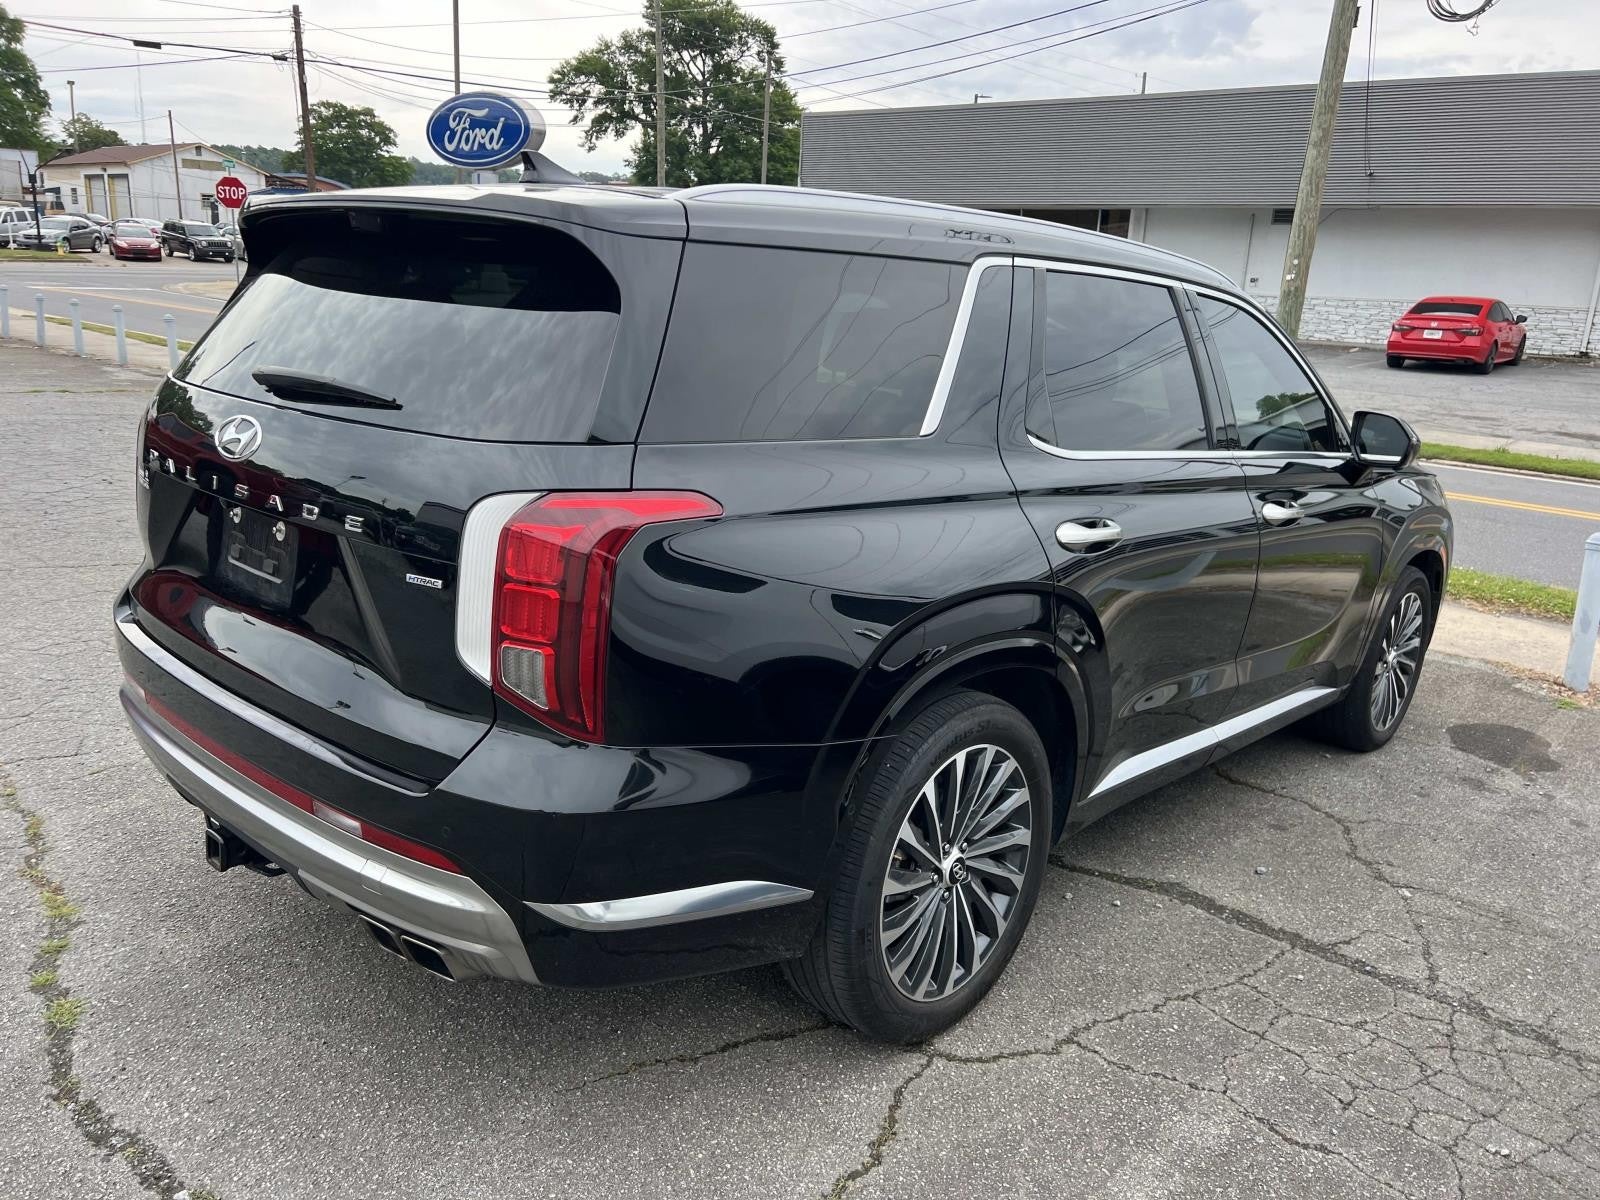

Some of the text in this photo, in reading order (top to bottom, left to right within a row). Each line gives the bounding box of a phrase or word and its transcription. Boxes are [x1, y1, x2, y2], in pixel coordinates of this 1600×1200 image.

[444, 107, 505, 151] Ford
[217, 186, 246, 200] STOP
[149, 448, 365, 533] PALISADE
[408, 575, 440, 588] HTRAC
